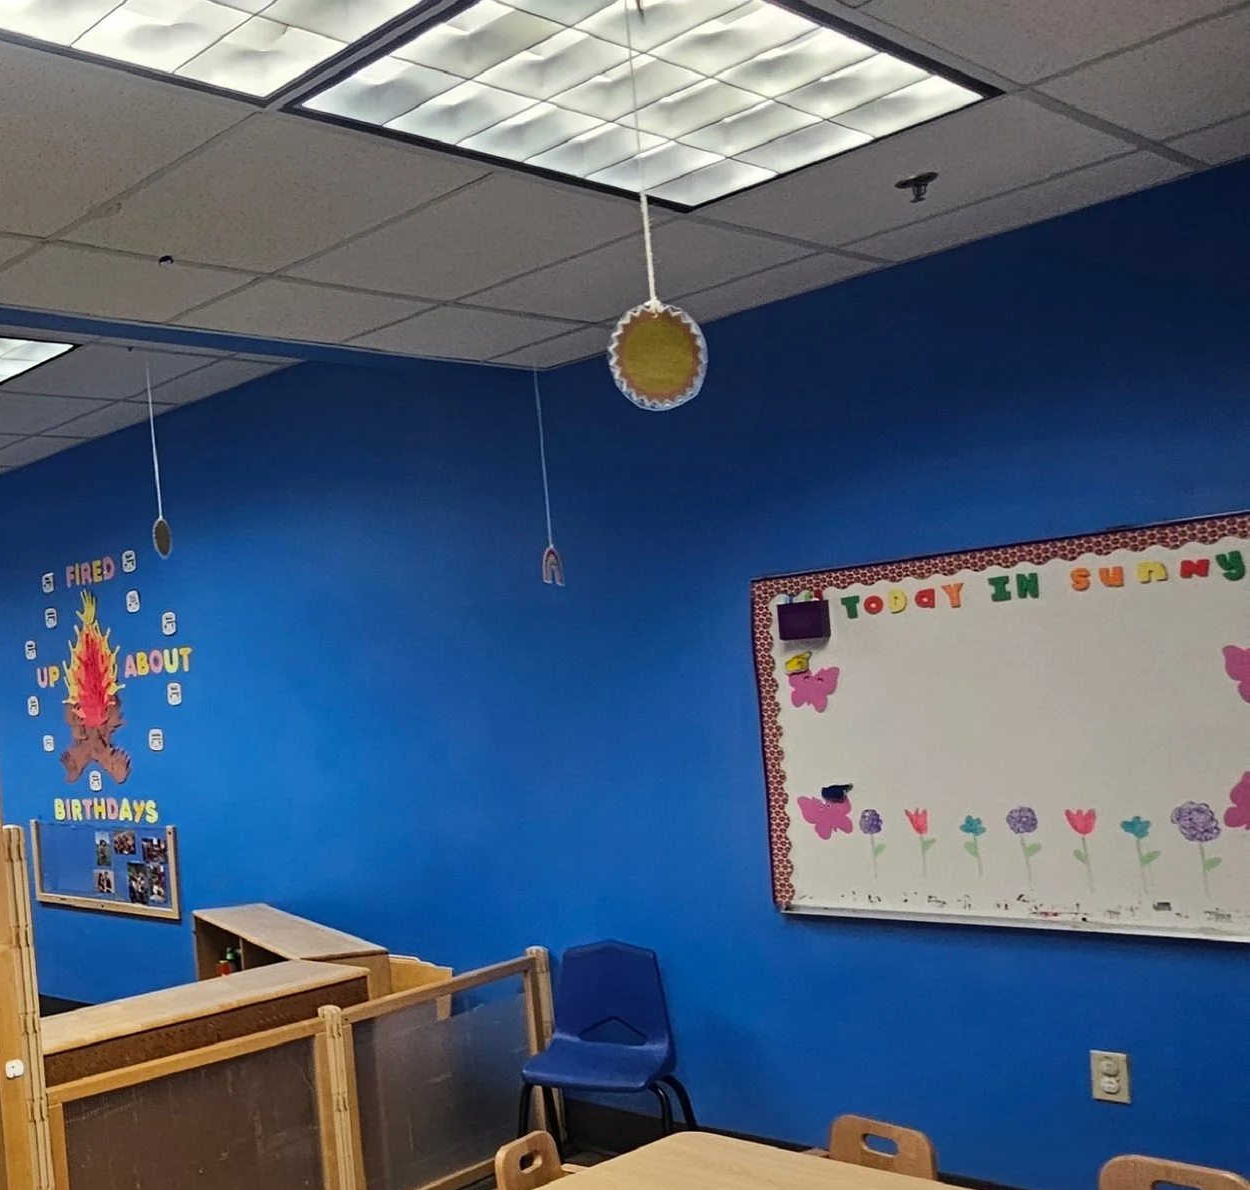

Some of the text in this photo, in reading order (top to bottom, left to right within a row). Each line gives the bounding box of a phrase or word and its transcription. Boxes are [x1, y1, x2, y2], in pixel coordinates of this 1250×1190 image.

[65, 556, 116, 588] FIRED
[987, 572, 1040, 602] IN
[36, 647, 193, 688] UP ABOUT
[53, 797, 159, 824] BIRTHDAYS
